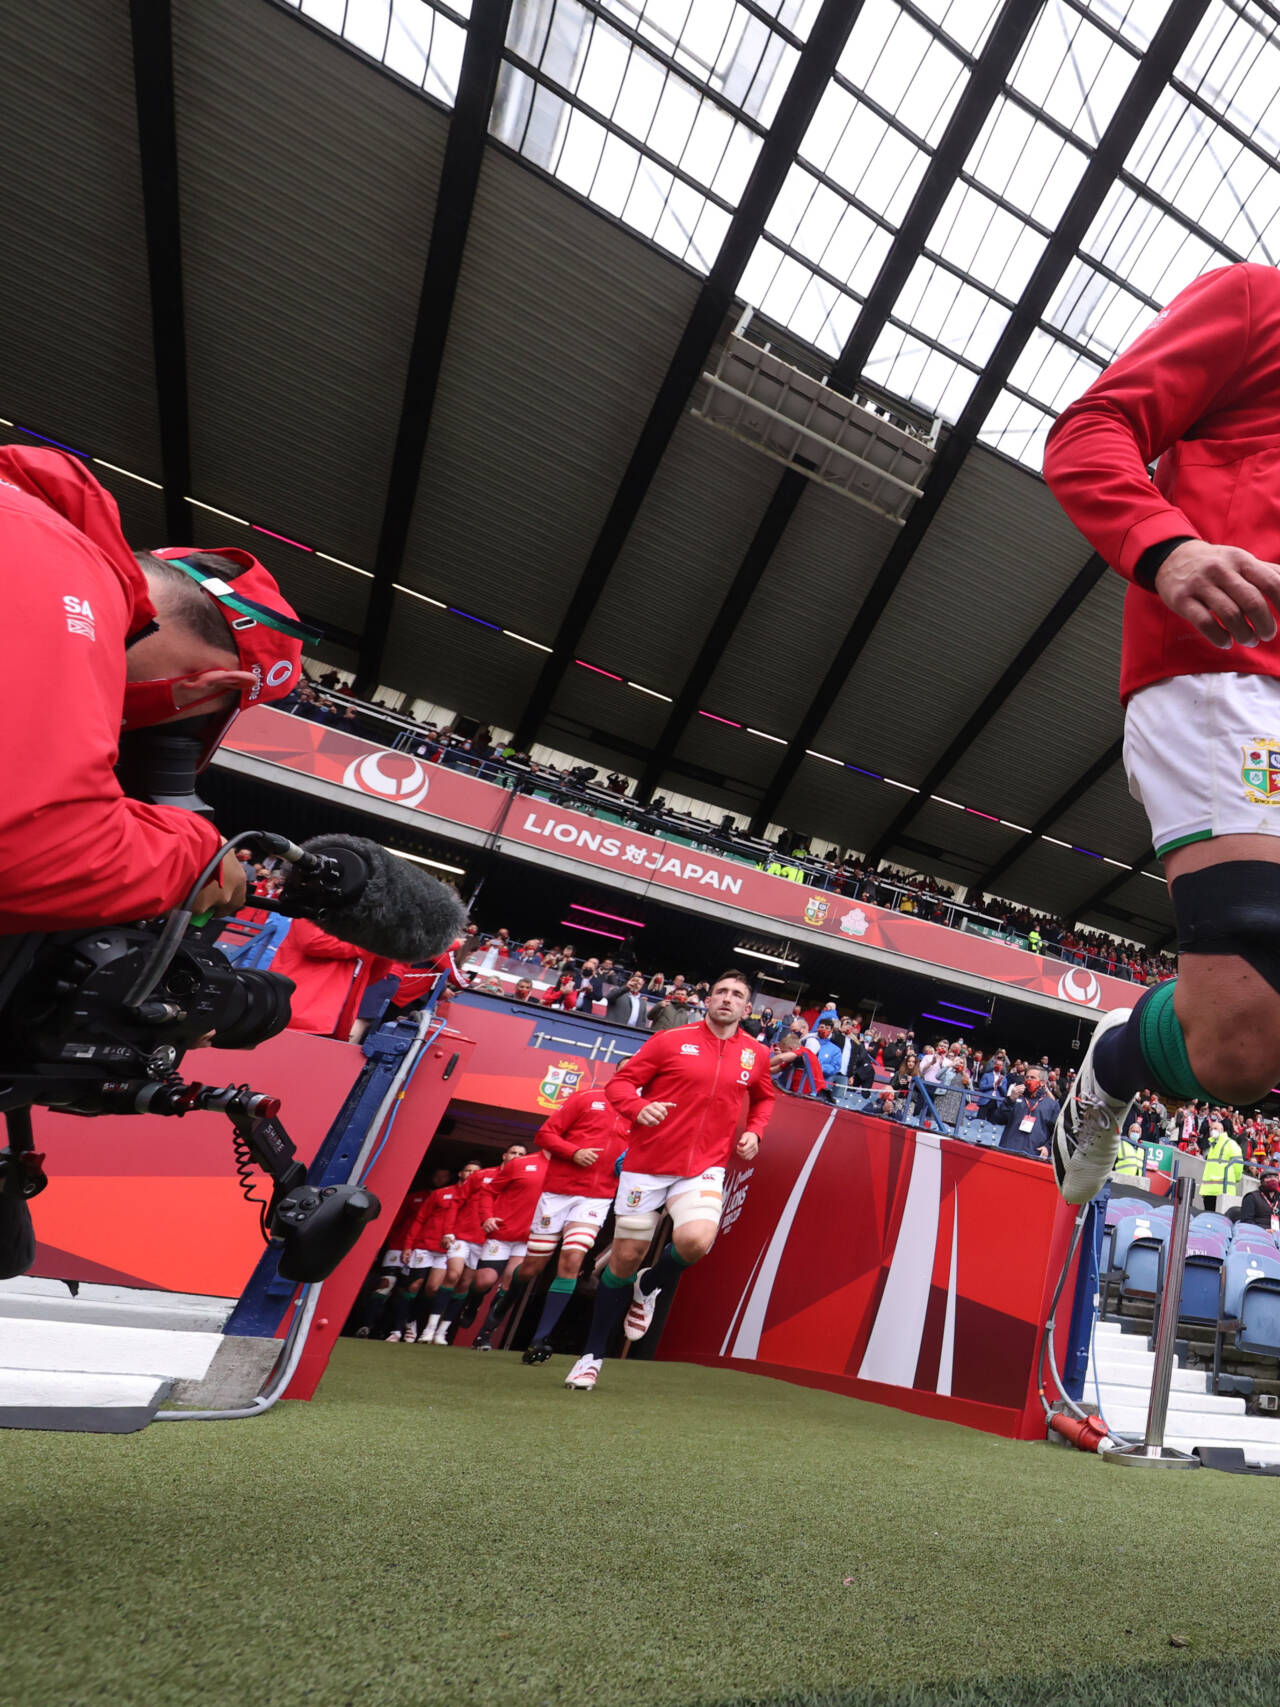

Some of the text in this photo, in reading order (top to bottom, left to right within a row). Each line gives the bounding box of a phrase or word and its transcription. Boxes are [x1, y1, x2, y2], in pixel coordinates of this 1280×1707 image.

[63, 595, 94, 620] SA
[523, 813, 743, 895] LIONS 対 JAPAN
[1147, 1147, 1164, 1161] 19
